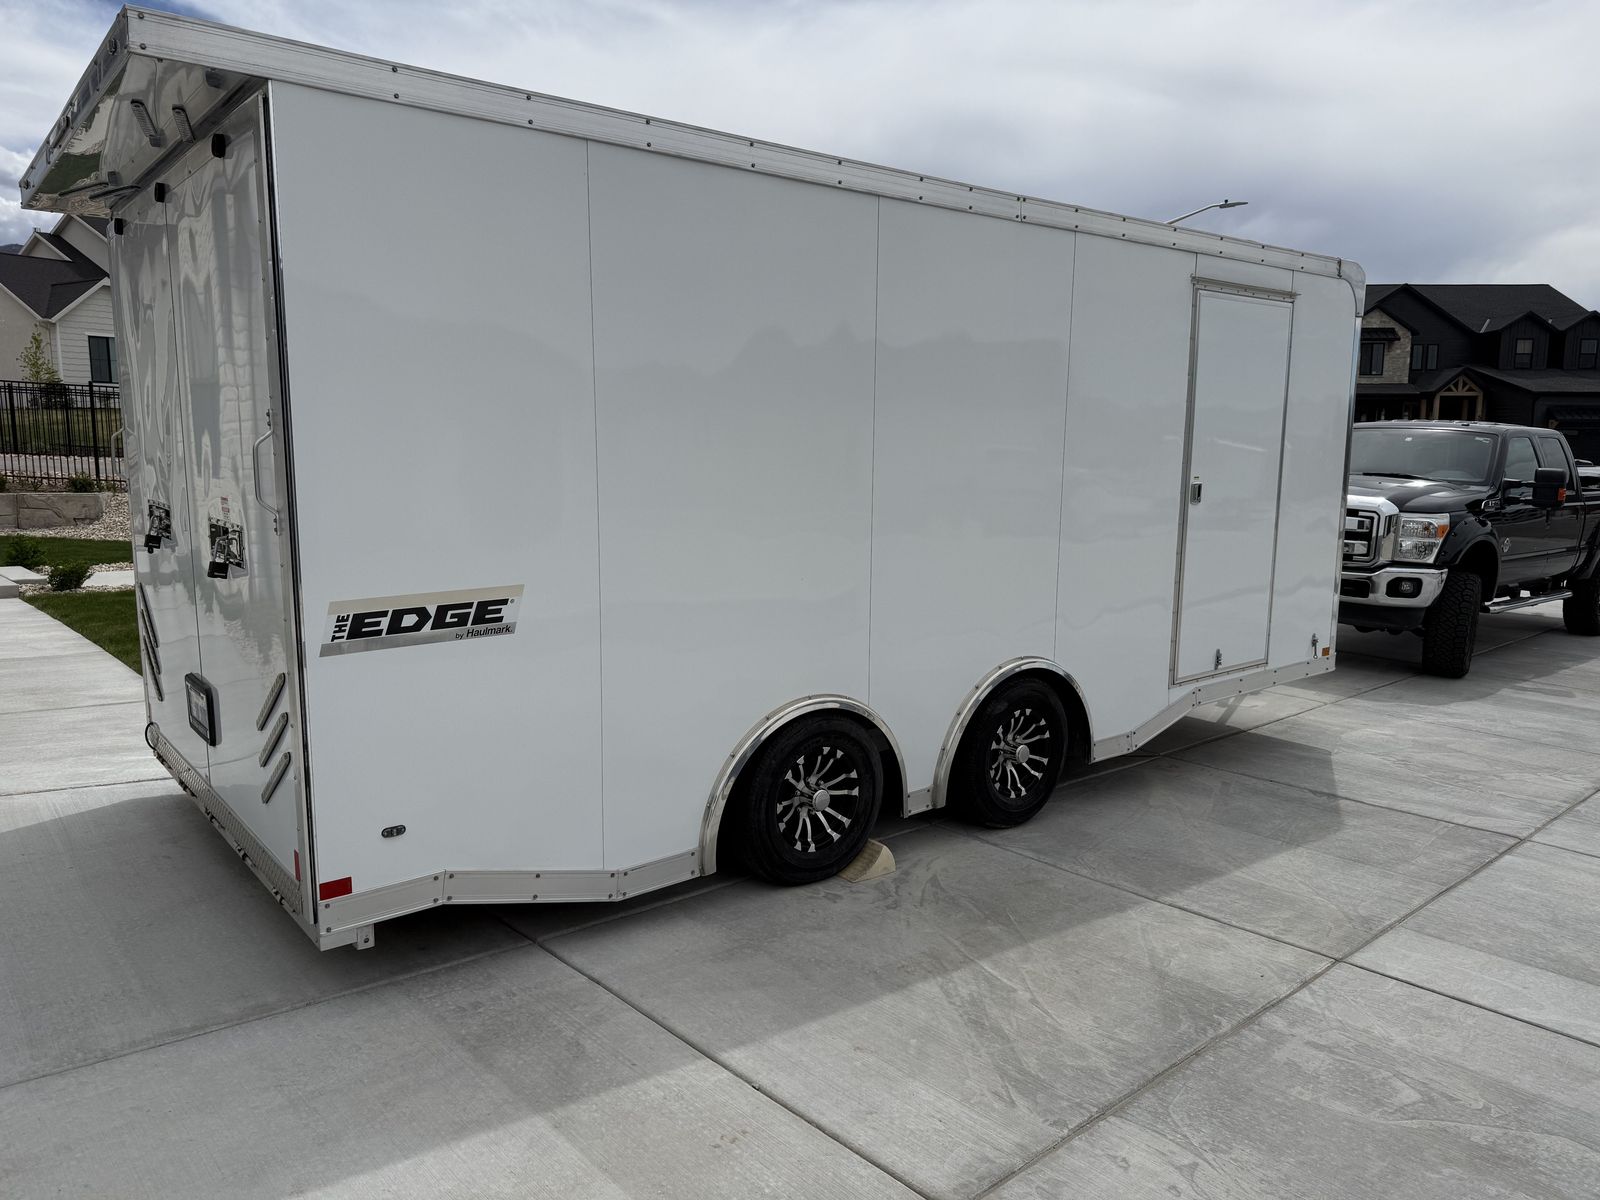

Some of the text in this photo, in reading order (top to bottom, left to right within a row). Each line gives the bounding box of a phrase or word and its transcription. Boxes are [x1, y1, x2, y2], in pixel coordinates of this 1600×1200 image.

[330, 598, 510, 642] THE EDGE
[455, 632, 464, 640] by
